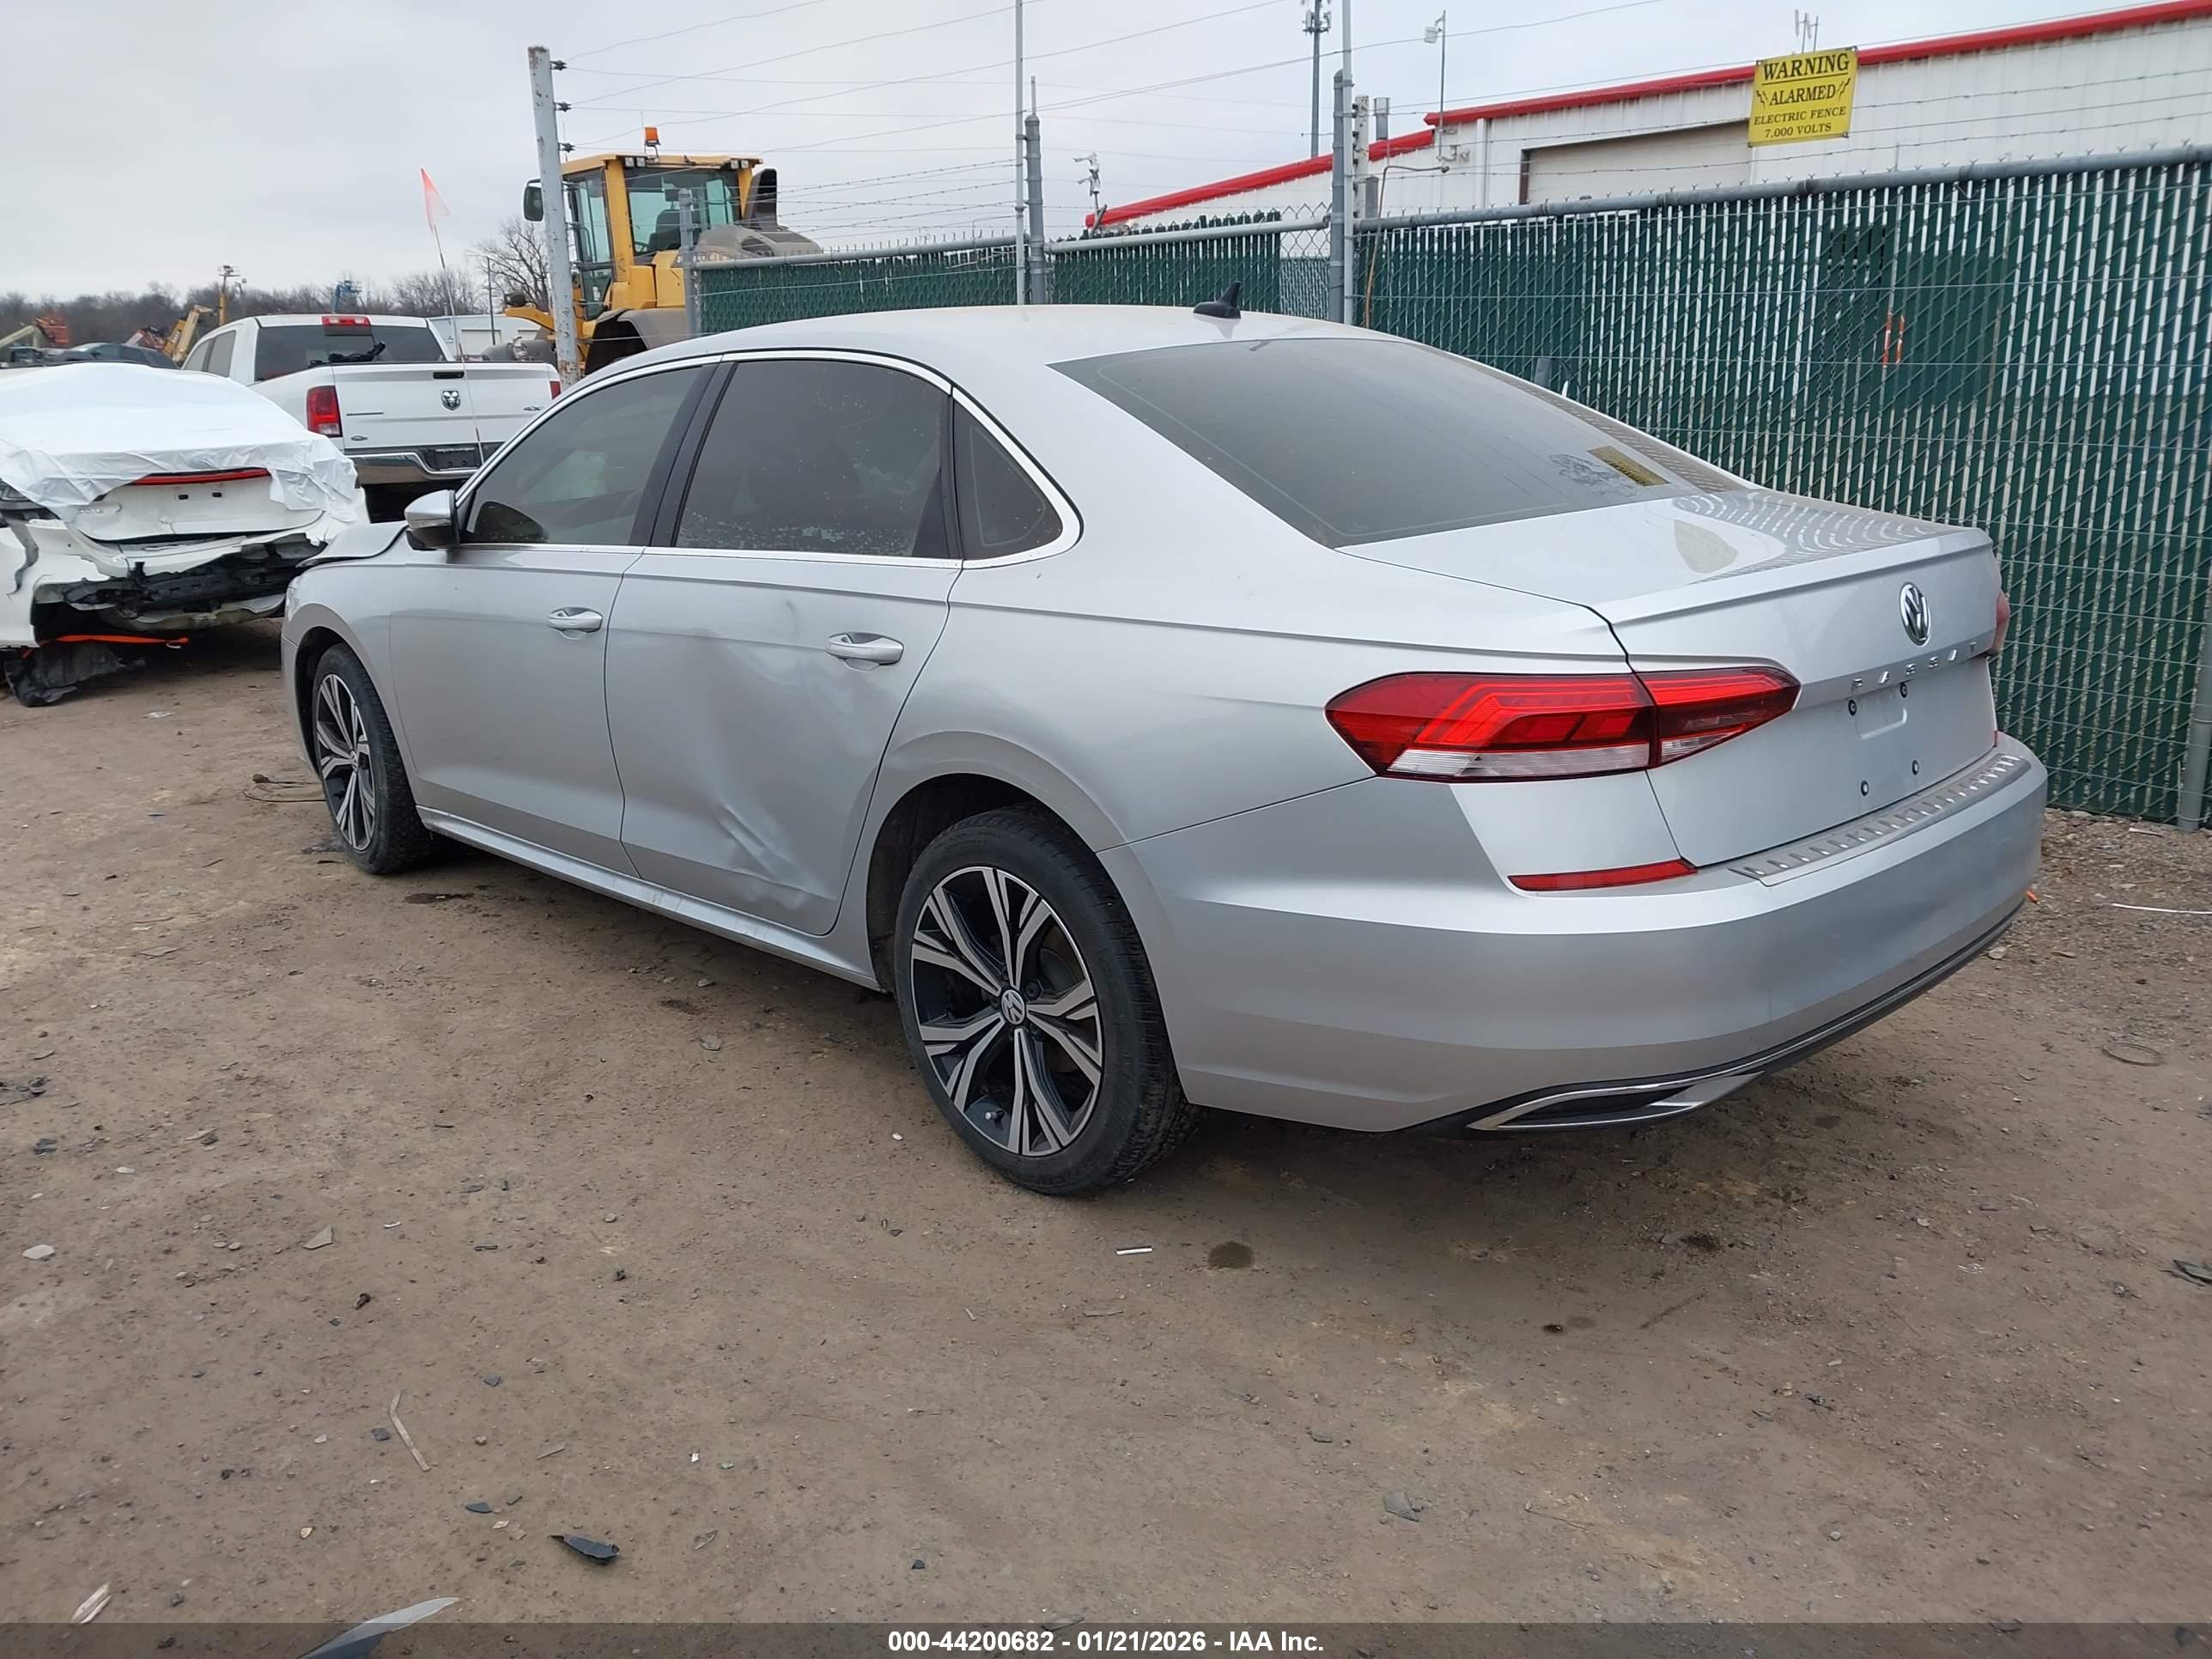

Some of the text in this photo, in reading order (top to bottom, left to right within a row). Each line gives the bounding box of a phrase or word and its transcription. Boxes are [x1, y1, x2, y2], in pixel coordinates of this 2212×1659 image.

[1763, 52, 1850, 81] WARNING
[1769, 83, 1836, 106] ALARMED
[1753, 106, 1847, 125] ELECTRIC FENCE
[1796, 122, 1832, 135] VOLTS
